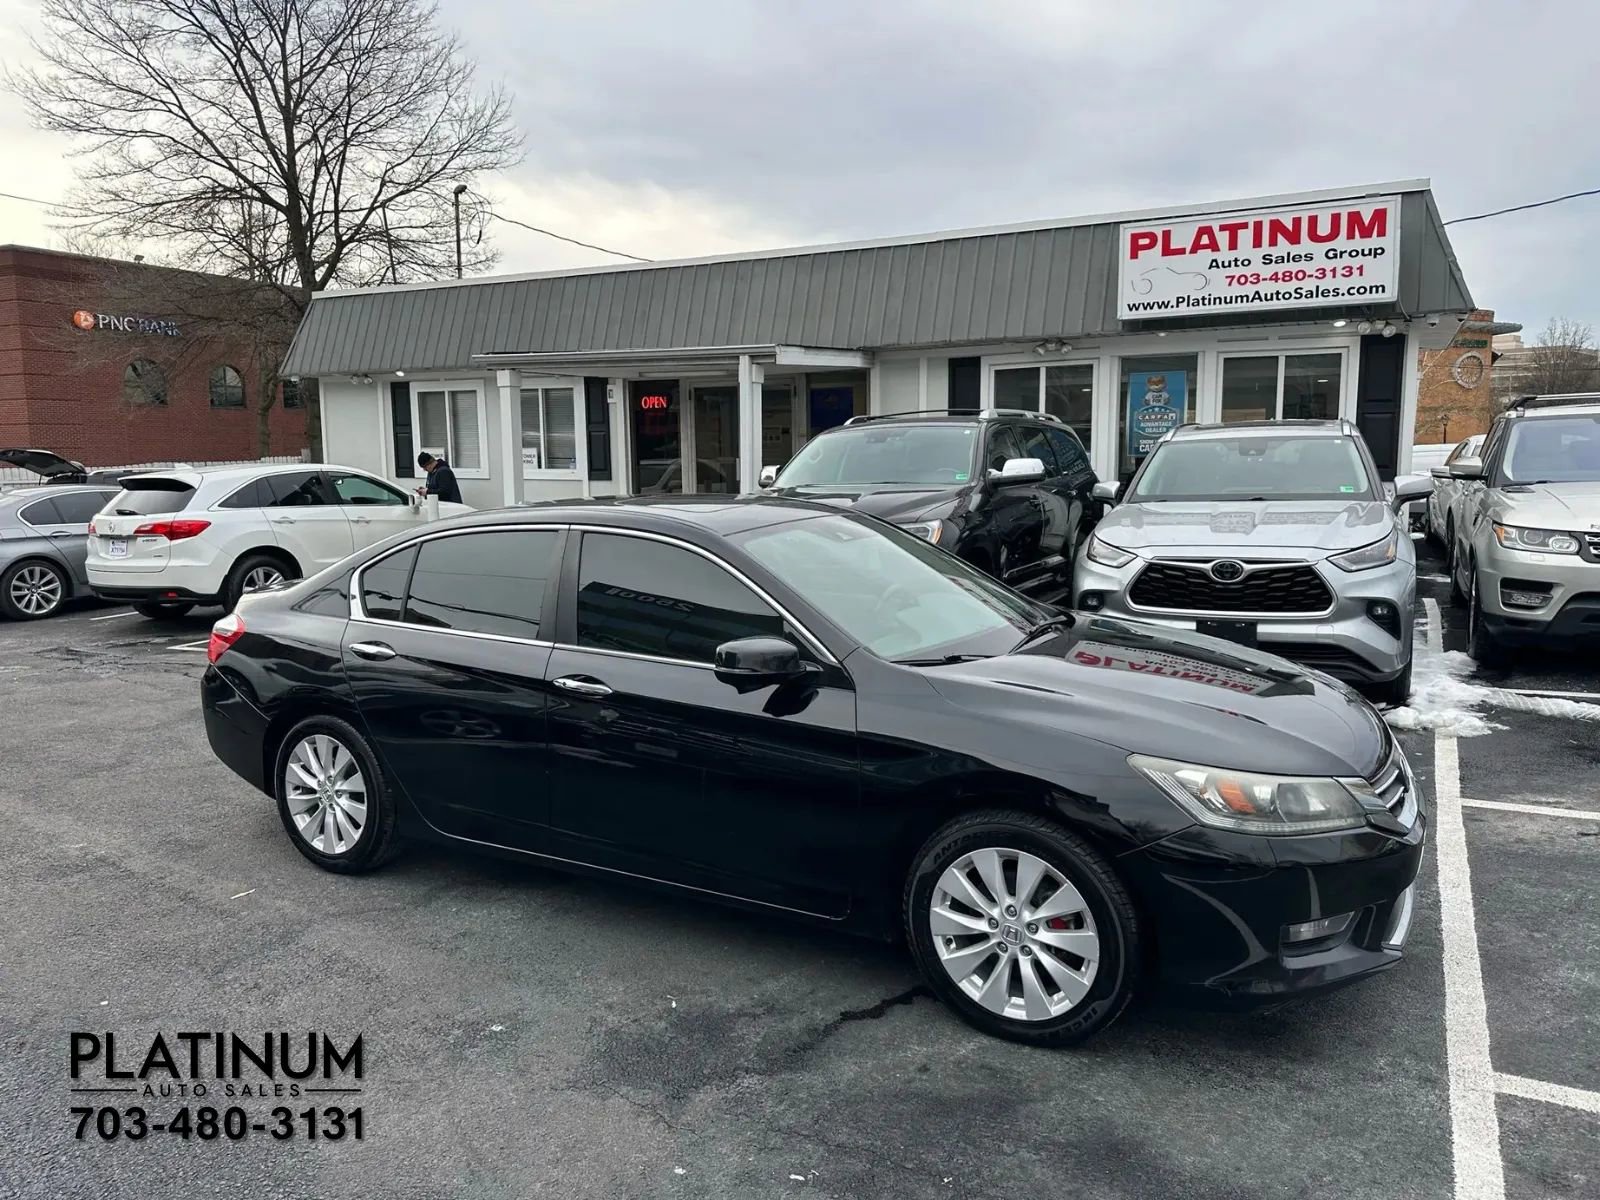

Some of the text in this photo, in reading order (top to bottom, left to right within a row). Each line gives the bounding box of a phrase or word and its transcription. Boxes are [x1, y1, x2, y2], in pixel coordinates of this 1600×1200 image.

[1129, 207, 1388, 260] PLATINUM
[1207, 245, 1386, 270] Auto Sales Group
[1225, 264, 1365, 287] 703-480-3131
[1127, 283, 1386, 313] www.PlatinumAutoSales.com
[97, 313, 136, 332] PNC
[641, 396, 667, 409] OPEN
